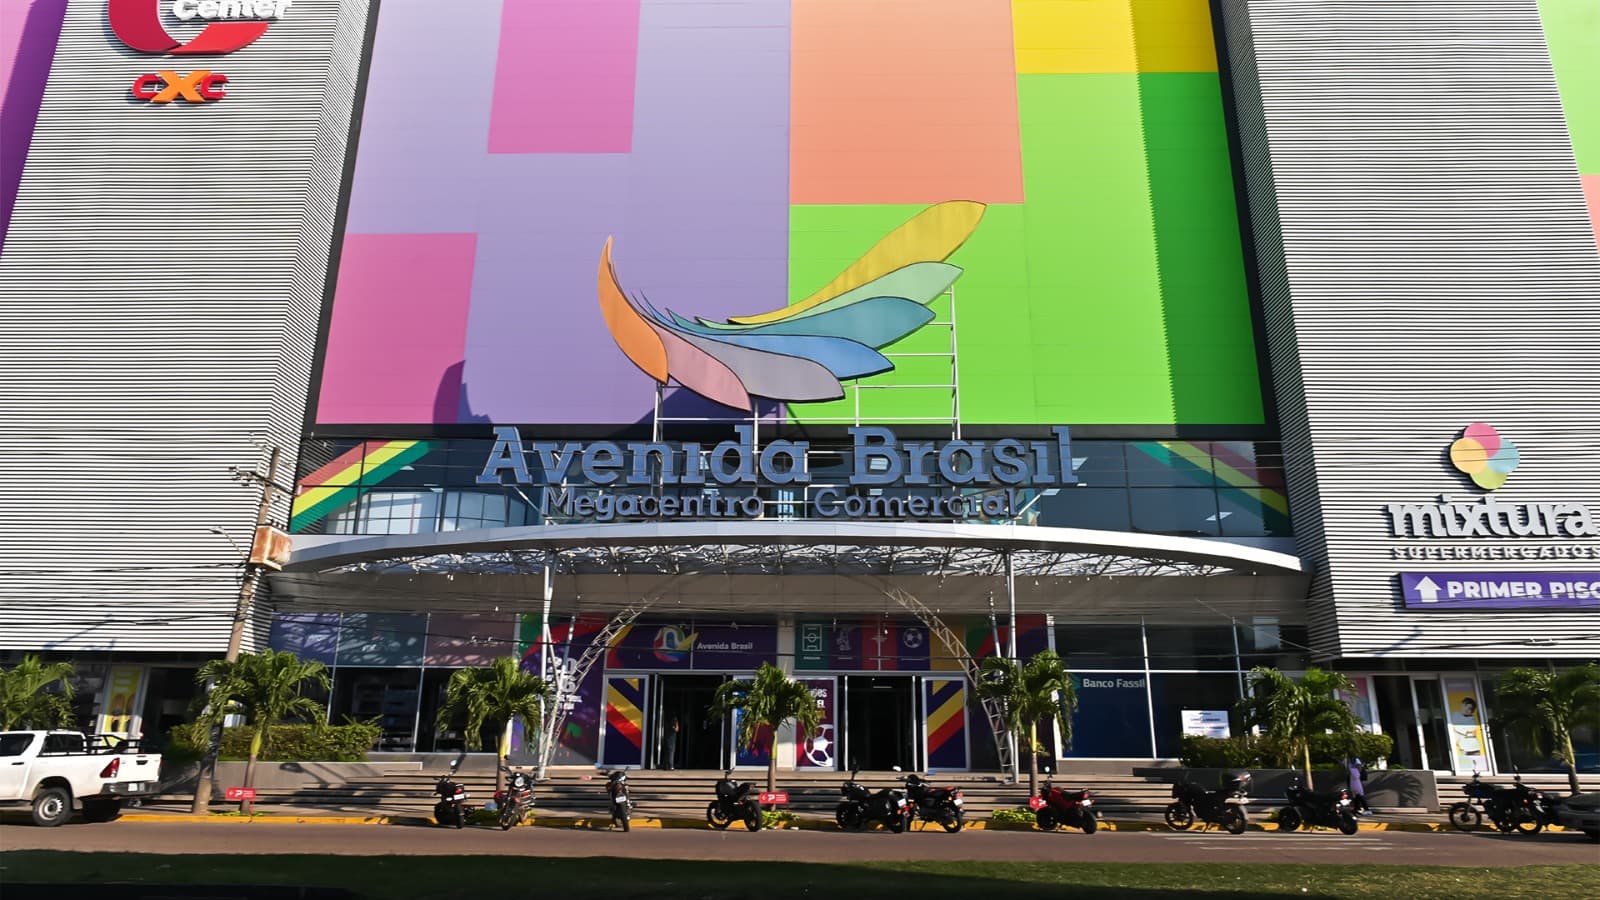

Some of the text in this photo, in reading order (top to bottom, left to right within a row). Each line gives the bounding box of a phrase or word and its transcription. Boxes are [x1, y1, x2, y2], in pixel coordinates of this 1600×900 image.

[172, 0, 291, 20] Center
[476, 425, 1078, 485] Avenida Brasil
[541, 486, 1018, 520] Megacentro Comercial
[1387, 493, 1600, 537] mixtura
[1393, 546, 1600, 559] SUPERMERCADOS
[1447, 581, 1542, 599] PRIMER
[697, 641, 753, 650] Avenida Brasil
[1083, 678, 1145, 688] Banco Fassil
